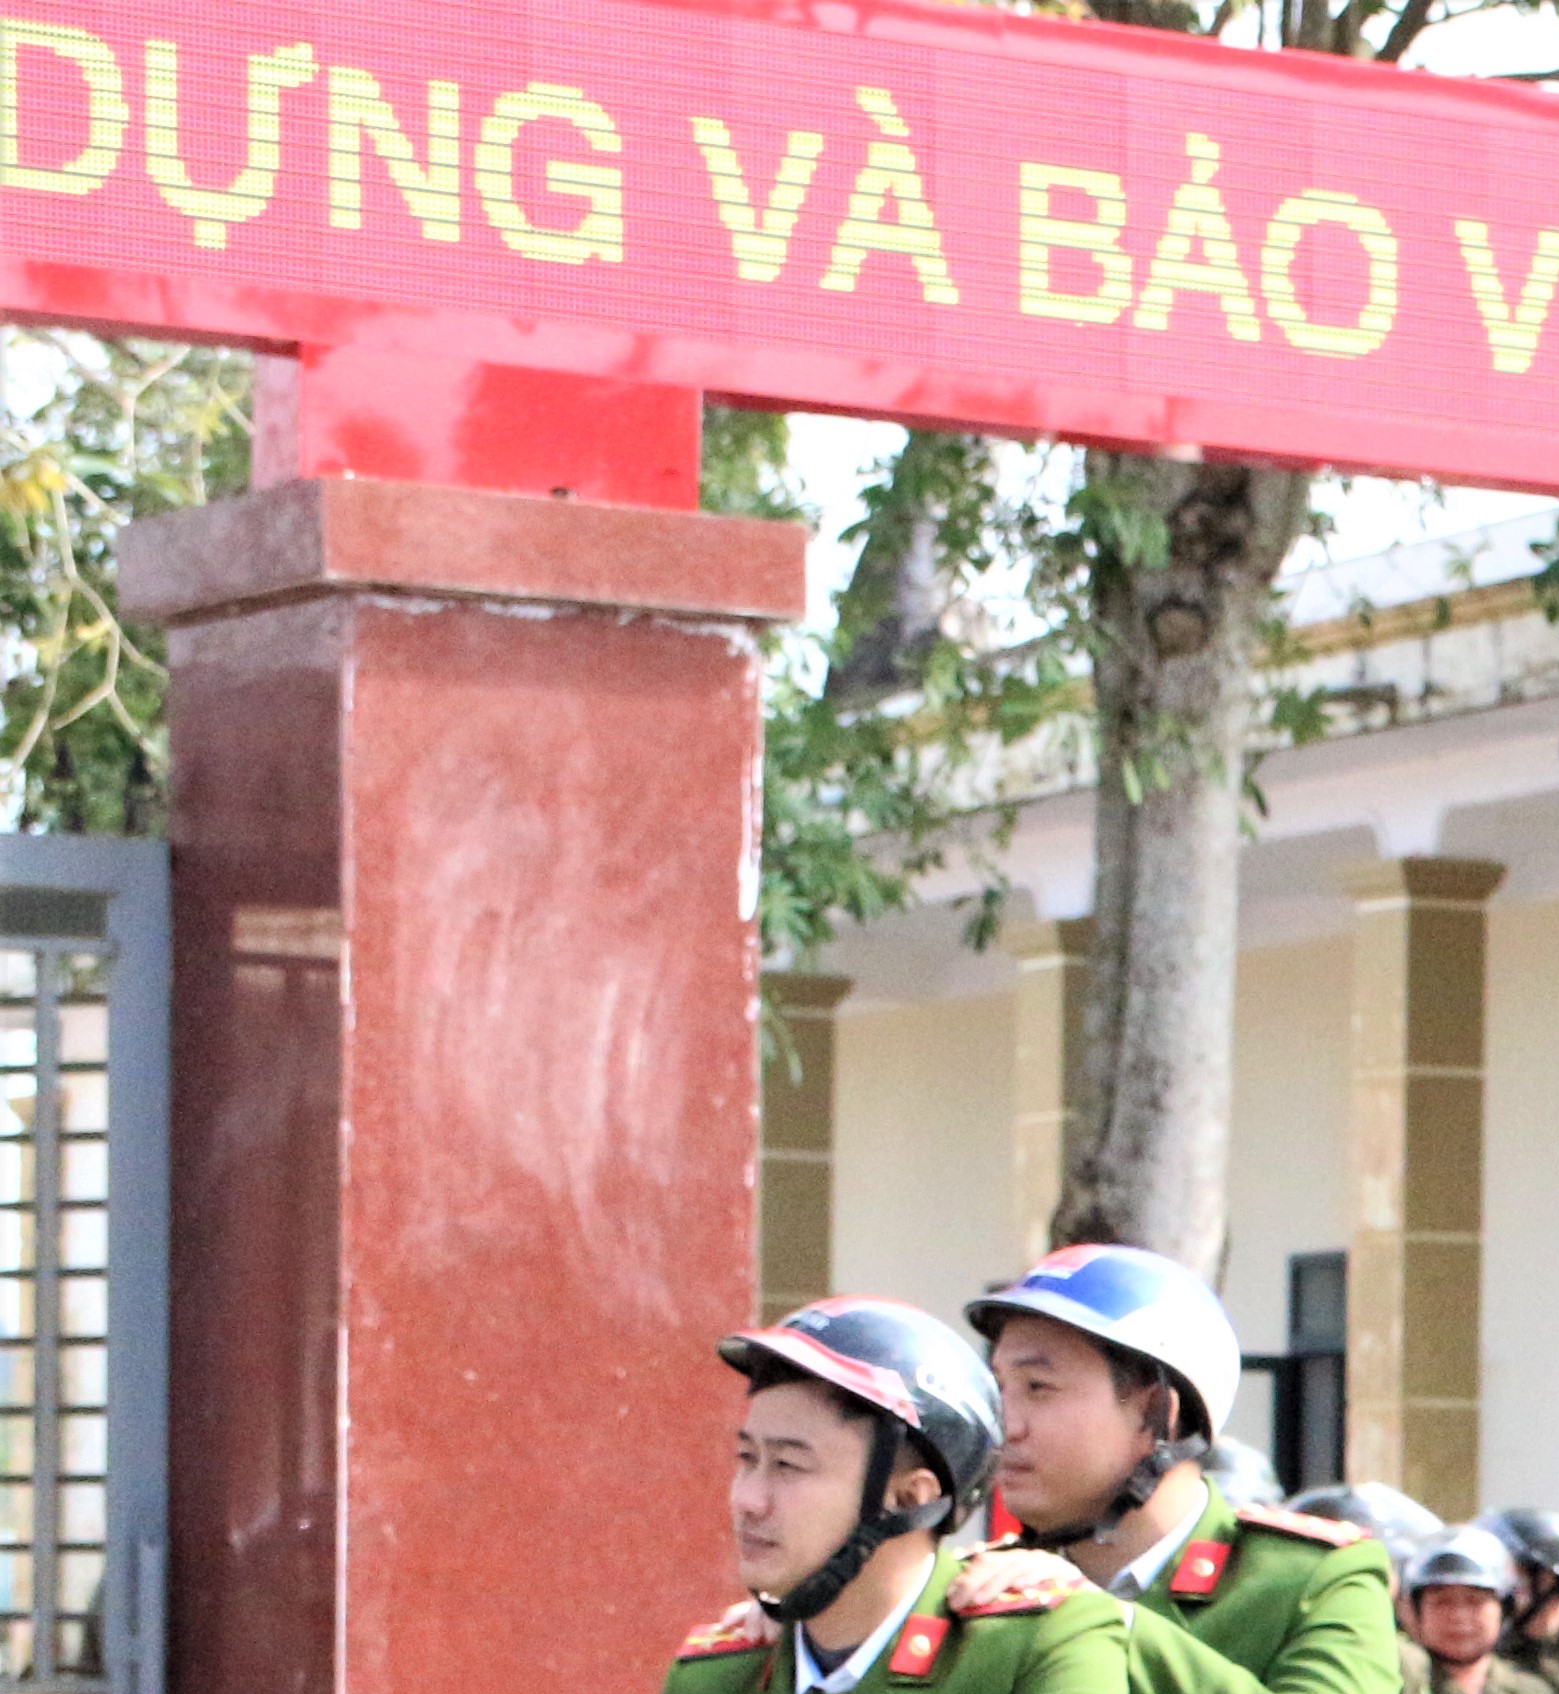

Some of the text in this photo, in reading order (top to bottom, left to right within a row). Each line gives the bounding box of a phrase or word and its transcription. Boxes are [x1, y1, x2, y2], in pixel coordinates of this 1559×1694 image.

[0, 18, 623, 263] DỰNG
[690, 86, 959, 306] VÀ
[1018, 131, 1398, 358] BẢO
